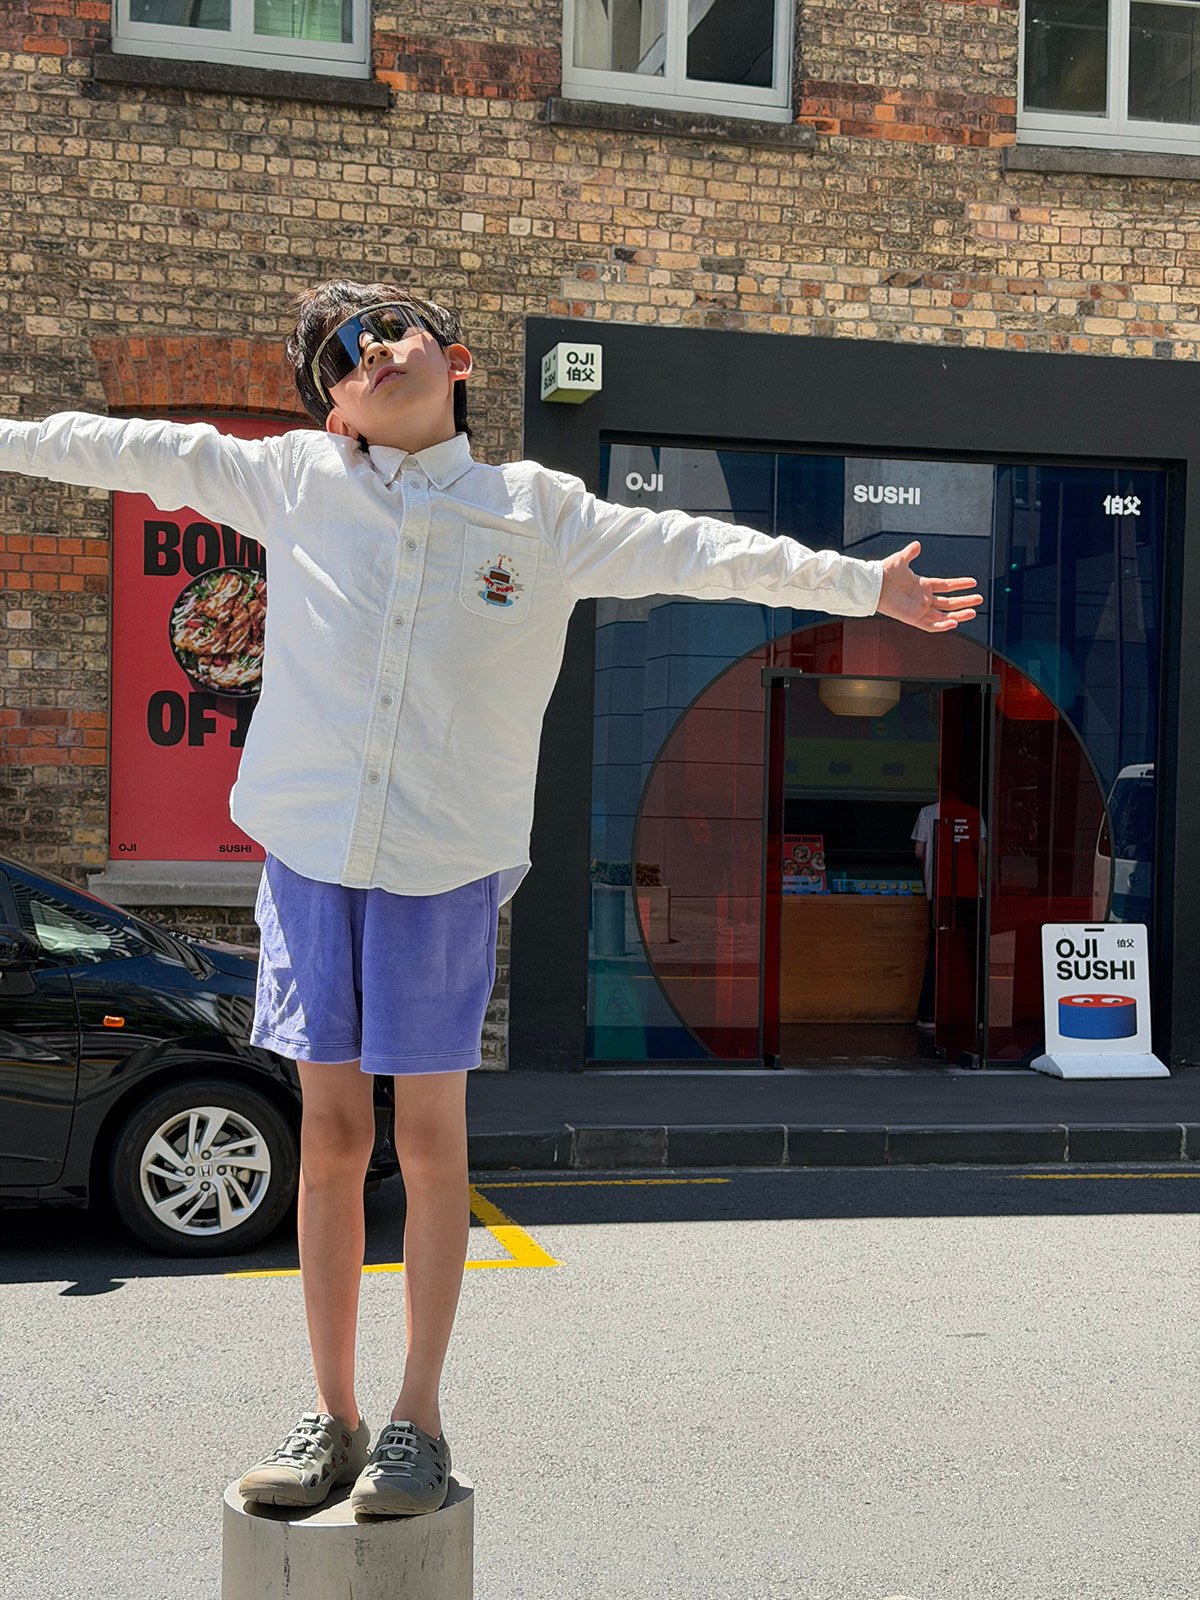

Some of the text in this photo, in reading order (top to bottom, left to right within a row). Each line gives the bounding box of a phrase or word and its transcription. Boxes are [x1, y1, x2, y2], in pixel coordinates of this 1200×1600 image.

[566, 351, 594, 366] OJI
[566, 367, 595, 383] 伯父
[625, 472, 921, 505] OJI SUSHI
[1103, 495, 1142, 516] 伯父
[147, 690, 217, 747] OF
[118, 843, 137, 852] OJI
[219, 844, 252, 853] SUSHI
[1055, 938, 1098, 959] OJI
[1116, 938, 1135, 949] 伯父
[1056, 960, 1136, 980] SUSHI
